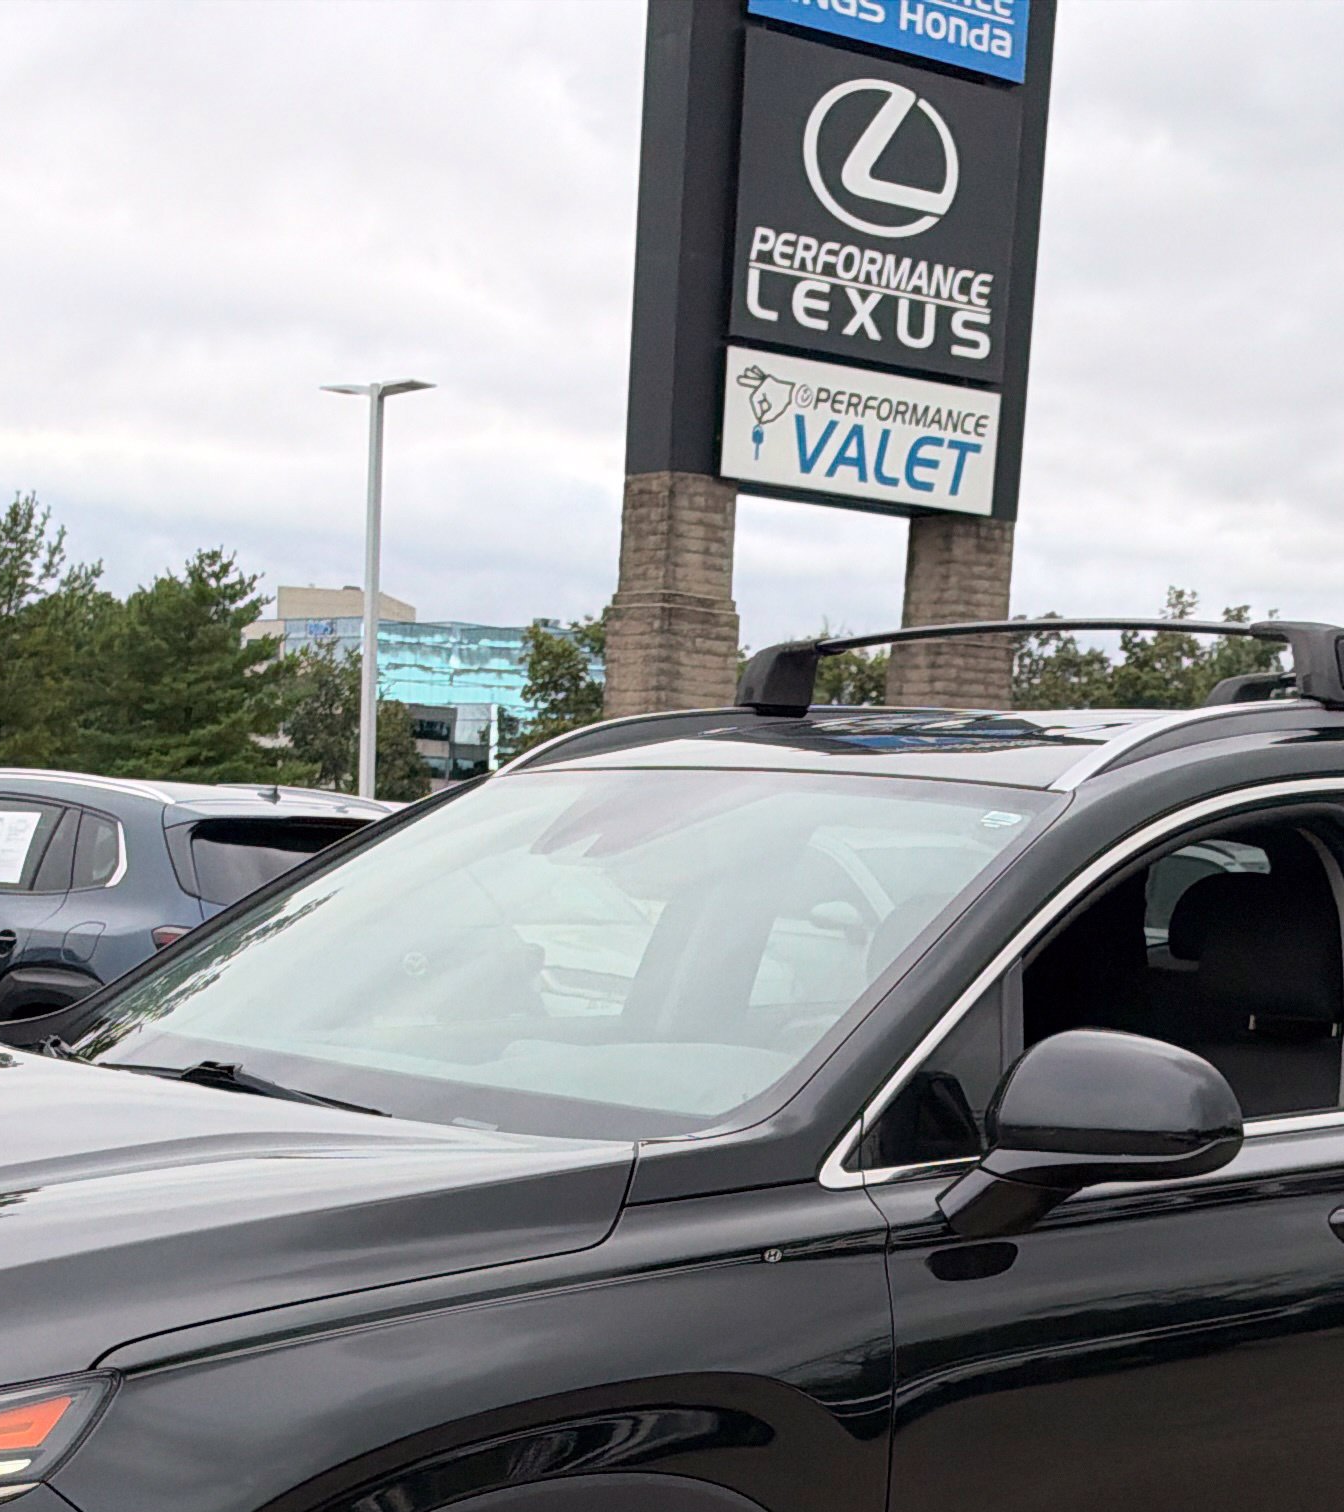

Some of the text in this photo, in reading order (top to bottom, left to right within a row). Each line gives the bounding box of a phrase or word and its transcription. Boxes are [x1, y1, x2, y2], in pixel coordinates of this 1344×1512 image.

[899, 3, 1012, 58] Honda
[749, 226, 994, 307] PERFORMANCE
[746, 268, 991, 360] LEXUS
[813, 387, 990, 437] PERFORMANCE
[794, 413, 983, 496] VALET
